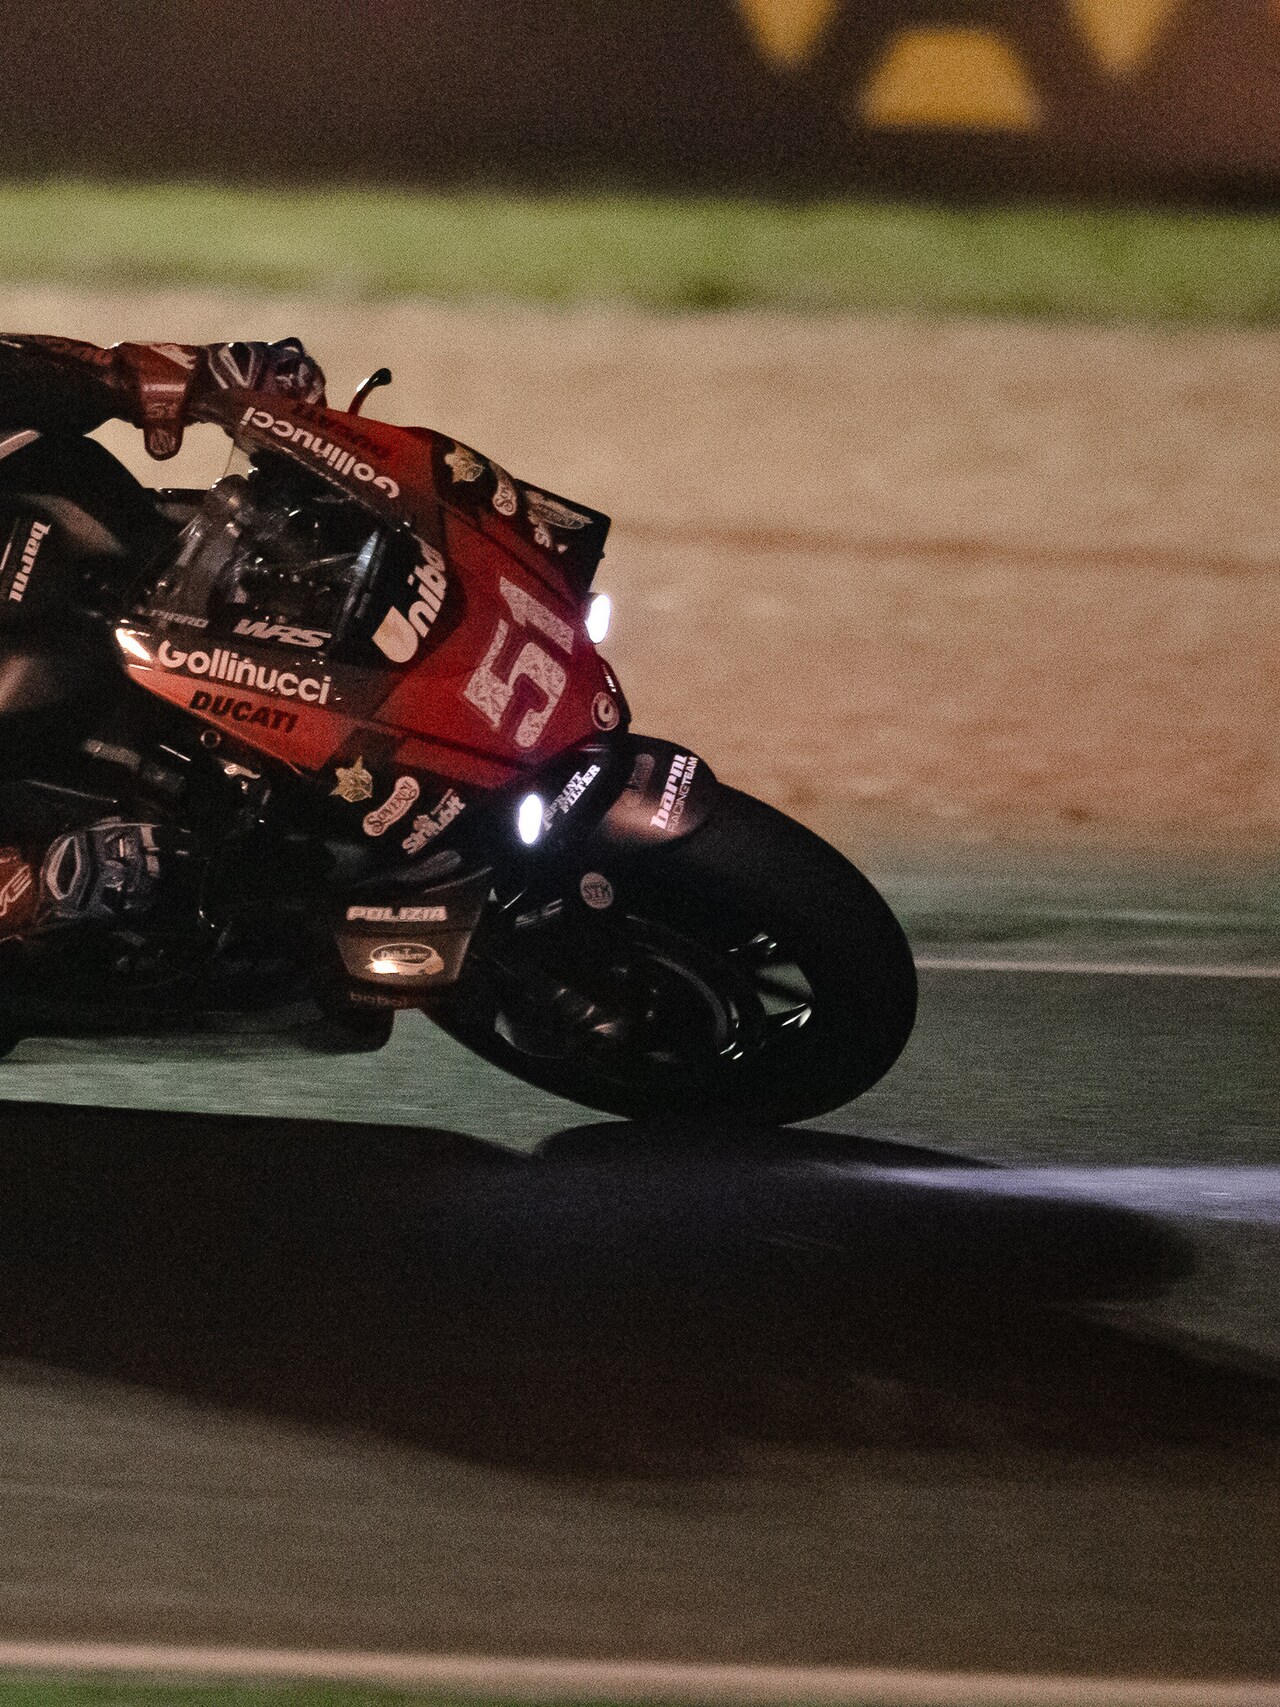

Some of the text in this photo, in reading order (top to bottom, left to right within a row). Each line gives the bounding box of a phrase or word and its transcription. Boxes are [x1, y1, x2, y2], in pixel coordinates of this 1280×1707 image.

[240, 406, 400, 499] Gollinucci
[8, 521, 51, 602] barni
[158, 639, 332, 705] Gollinucci
[463, 576, 575, 748] 51
[189, 690, 298, 734] DUCATI
[559, 763, 601, 814] FILTER
[650, 754, 689, 830] barni
[346, 905, 448, 922] POLIZIA
